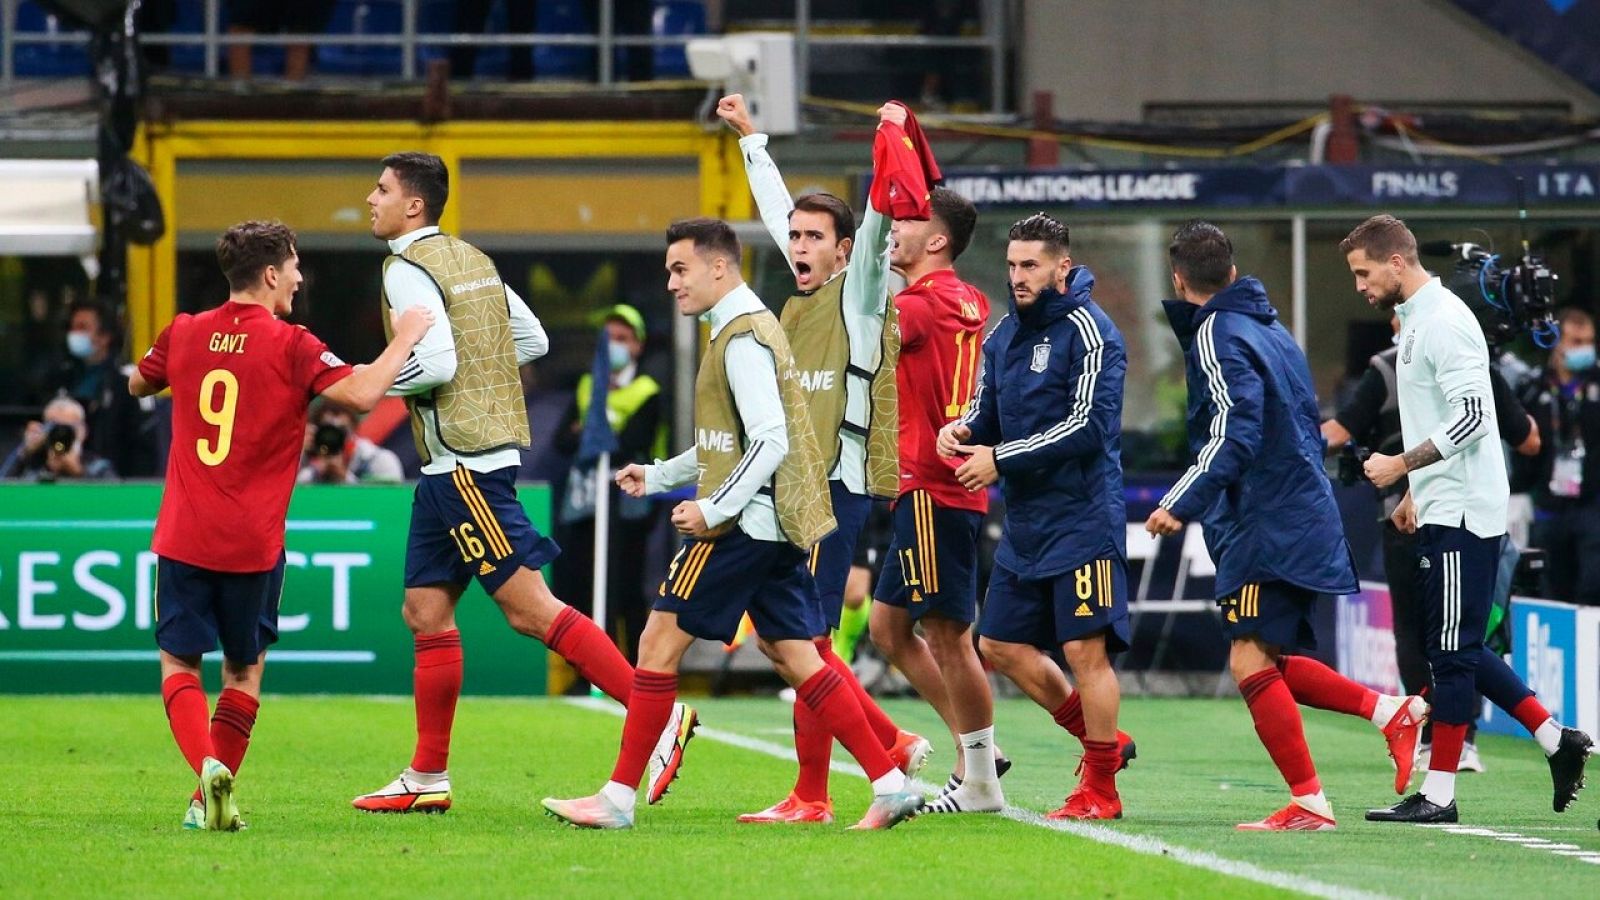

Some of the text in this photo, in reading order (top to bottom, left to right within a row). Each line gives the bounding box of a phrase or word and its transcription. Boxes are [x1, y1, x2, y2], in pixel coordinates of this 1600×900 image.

[1002, 175, 1104, 202] NATIONS
[1105, 173, 1197, 200] LEAGUE
[1371, 171, 1458, 197] FINALS
[209, 331, 248, 354] GAVI
[945, 329, 977, 417] 11
[196, 368, 239, 467] 9
[695, 427, 734, 453] AME
[449, 522, 486, 563] 16
[1074, 563, 1093, 600] 8
